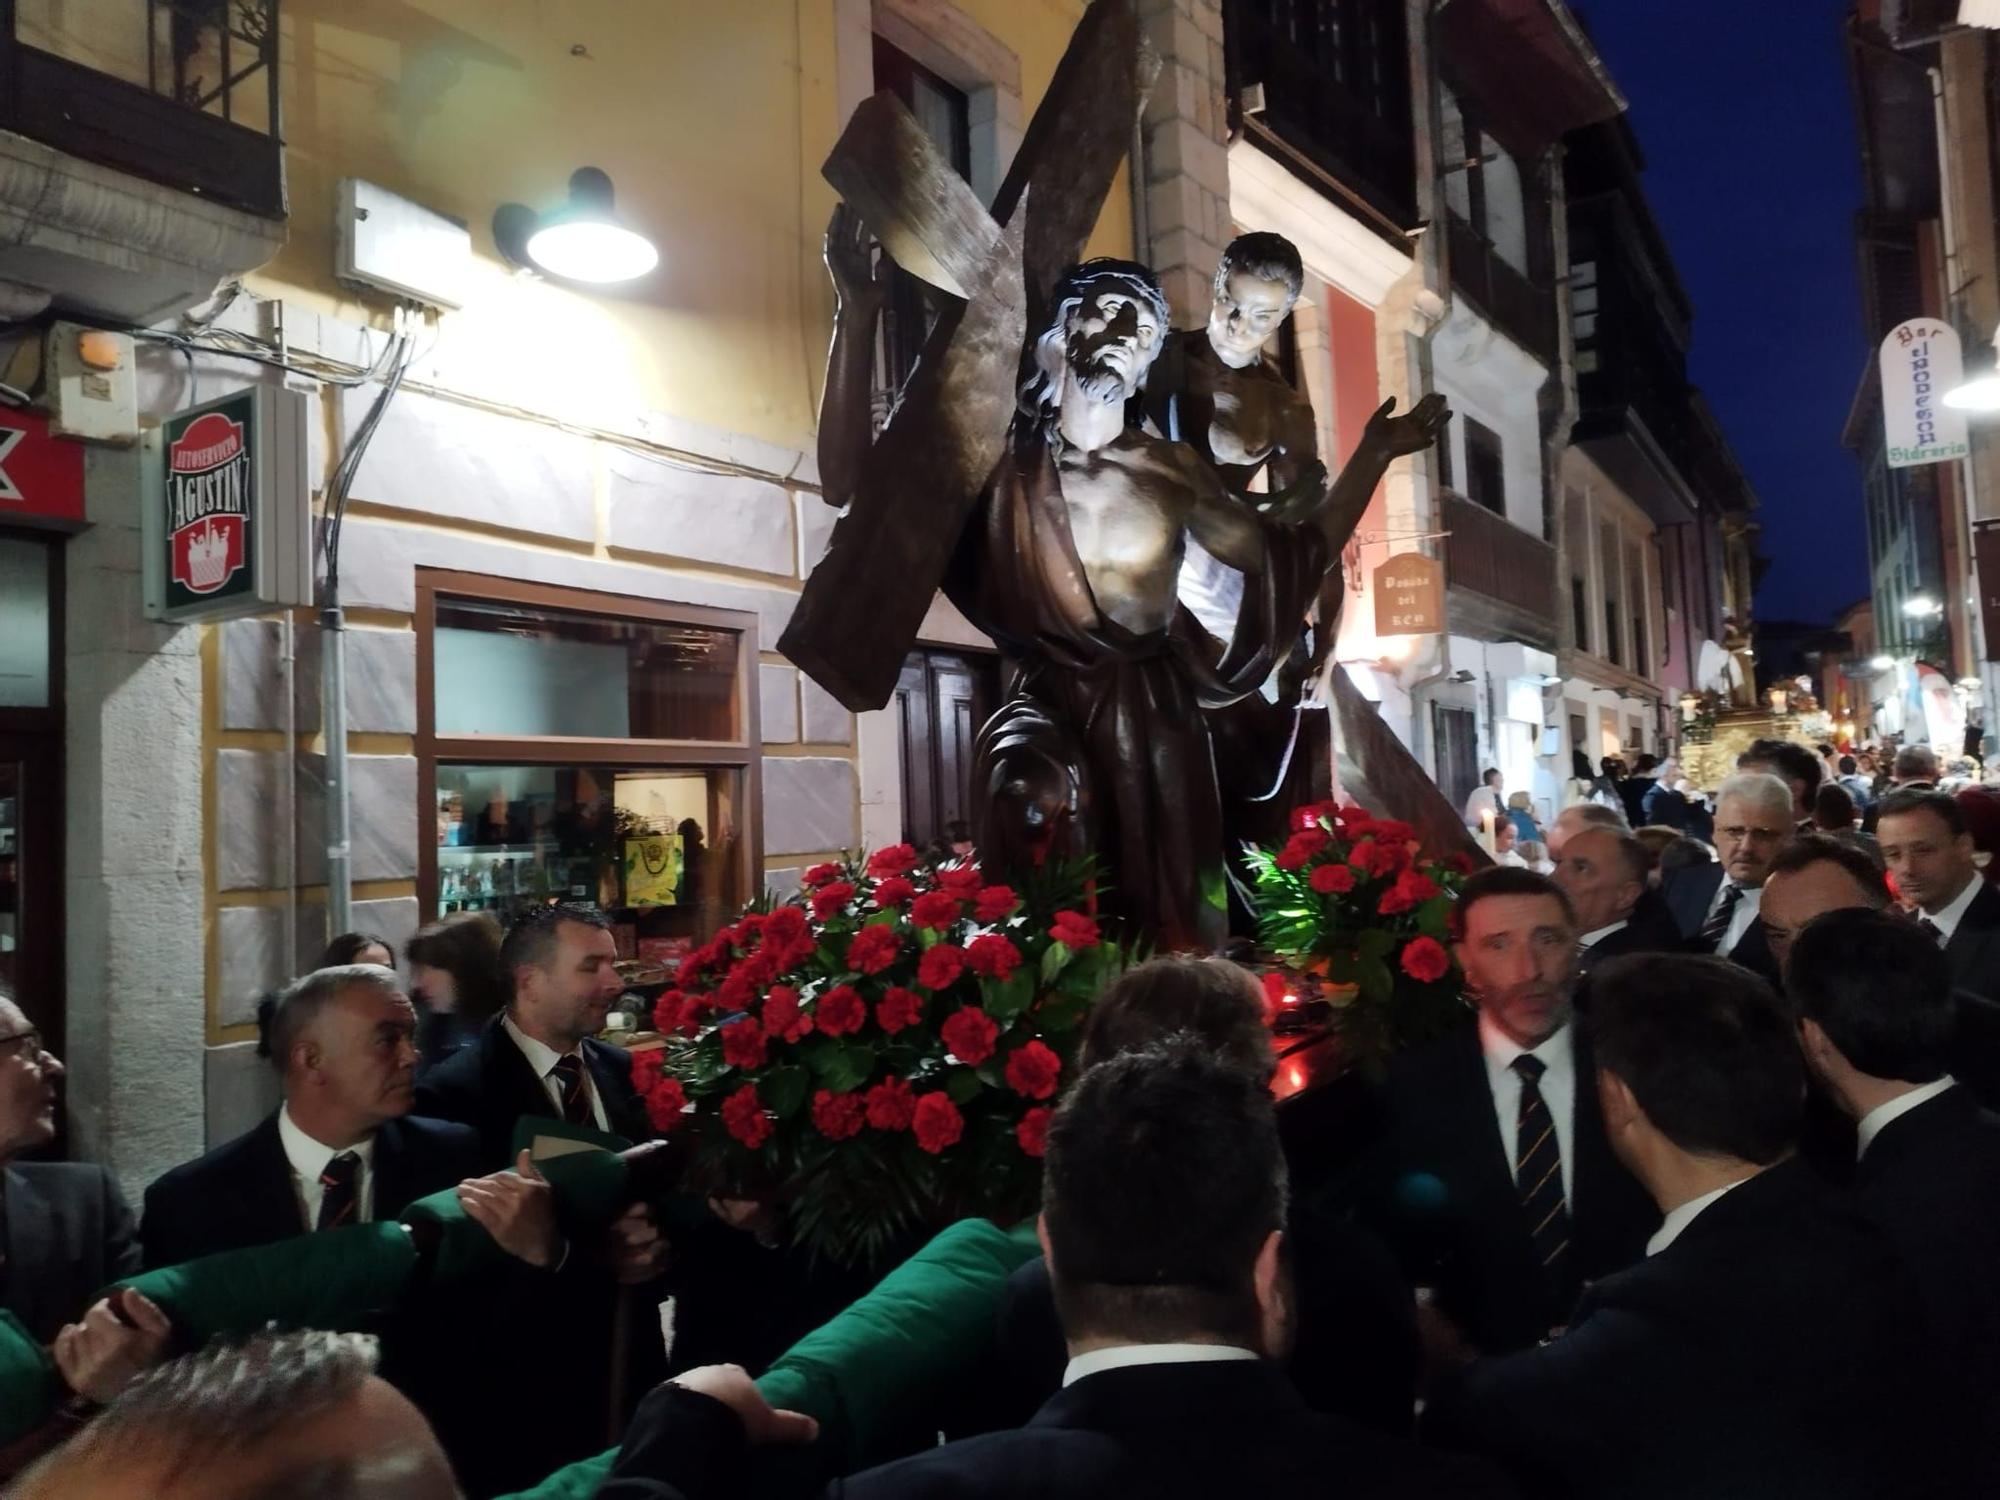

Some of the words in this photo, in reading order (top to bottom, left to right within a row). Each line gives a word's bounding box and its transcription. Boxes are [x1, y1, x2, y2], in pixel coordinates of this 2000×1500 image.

[1896, 326, 1942, 348] Bar
[176, 434, 237, 469] AUTOSERVICIO
[175, 458, 242, 530] AGUSTIN
